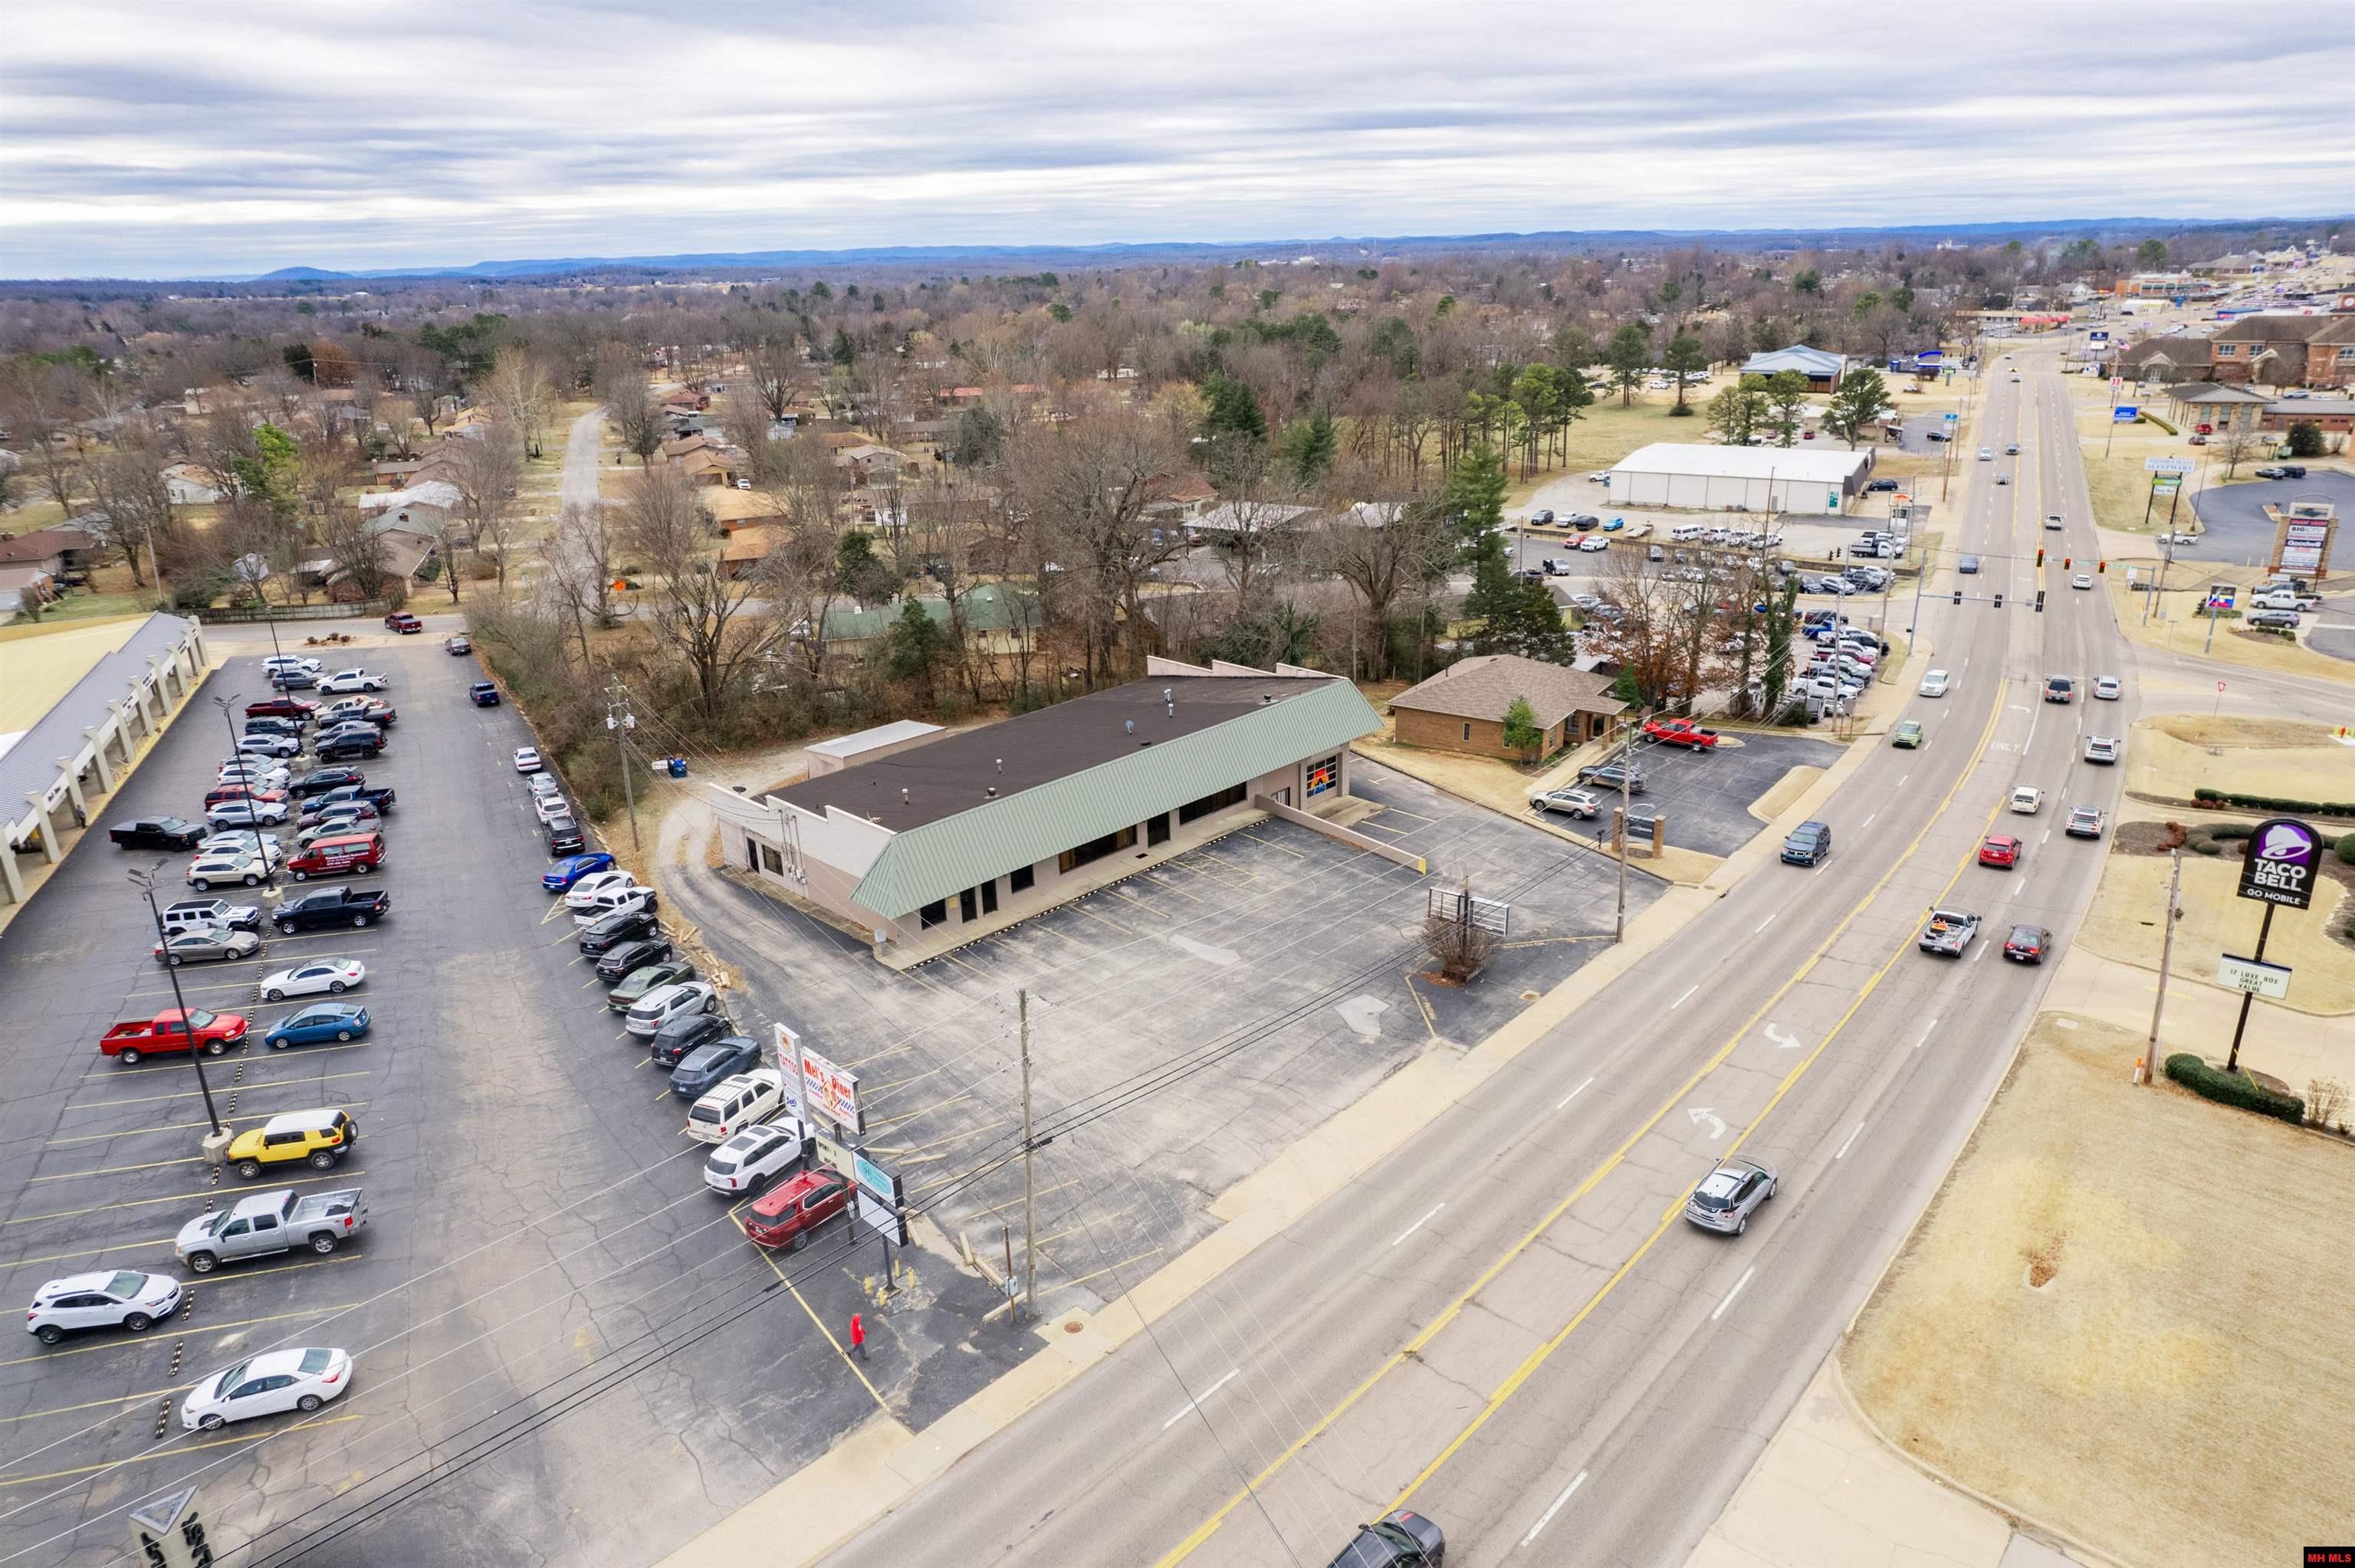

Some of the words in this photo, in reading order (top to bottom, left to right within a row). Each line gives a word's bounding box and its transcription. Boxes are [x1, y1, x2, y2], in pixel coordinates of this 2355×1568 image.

[1990, 741, 2021, 753] ONLY
[2255, 858, 2306, 879] TACO
[2254, 871, 2301, 891] BELL
[2247, 888, 2263, 897] GO
[2265, 891, 2301, 904] MOBILE
[2239, 978, 2262, 986] GREAT
[2241, 971, 2258, 979] LUXE
[2238, 983, 2260, 992] VALUE
[778, 1054, 798, 1075] TATTOO
[804, 1059, 825, 1082] Mel's
[831, 1075, 851, 1100] Diner
